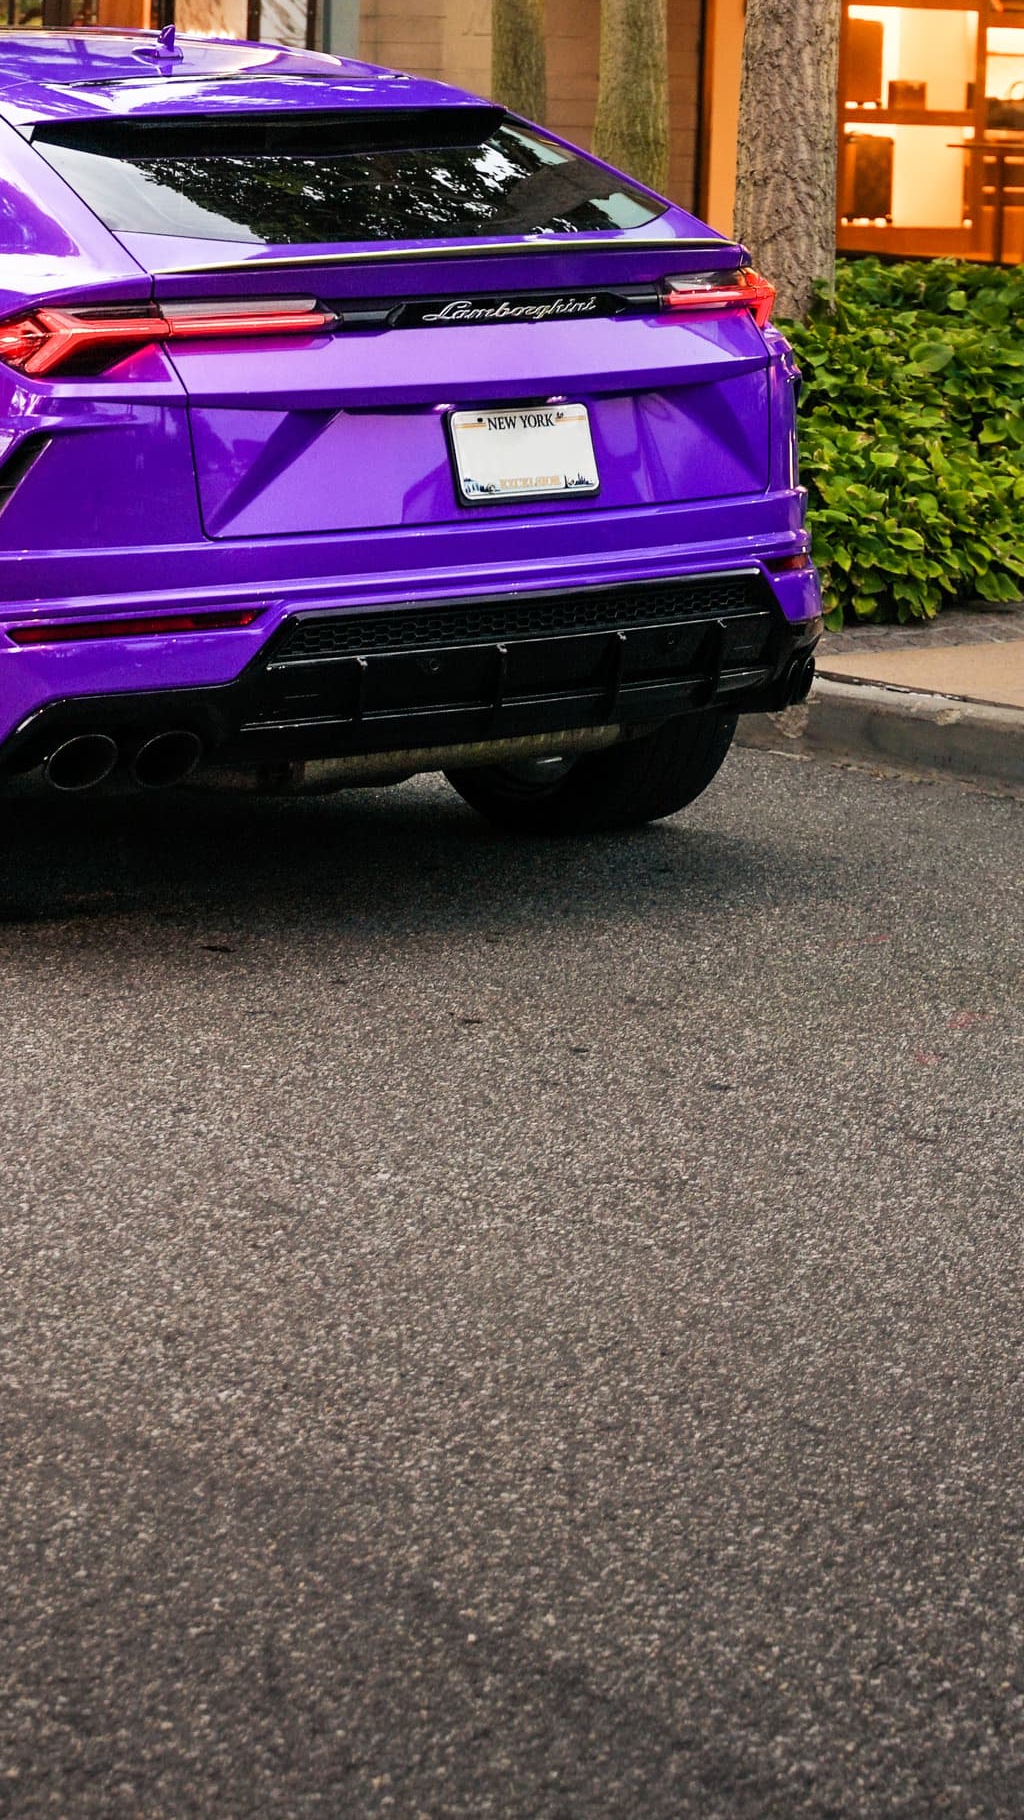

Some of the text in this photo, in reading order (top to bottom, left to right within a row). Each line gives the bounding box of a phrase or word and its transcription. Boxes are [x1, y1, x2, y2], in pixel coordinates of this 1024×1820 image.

[422, 296, 598, 322] Lamborghini
[487, 413, 555, 431] NEW YORK
